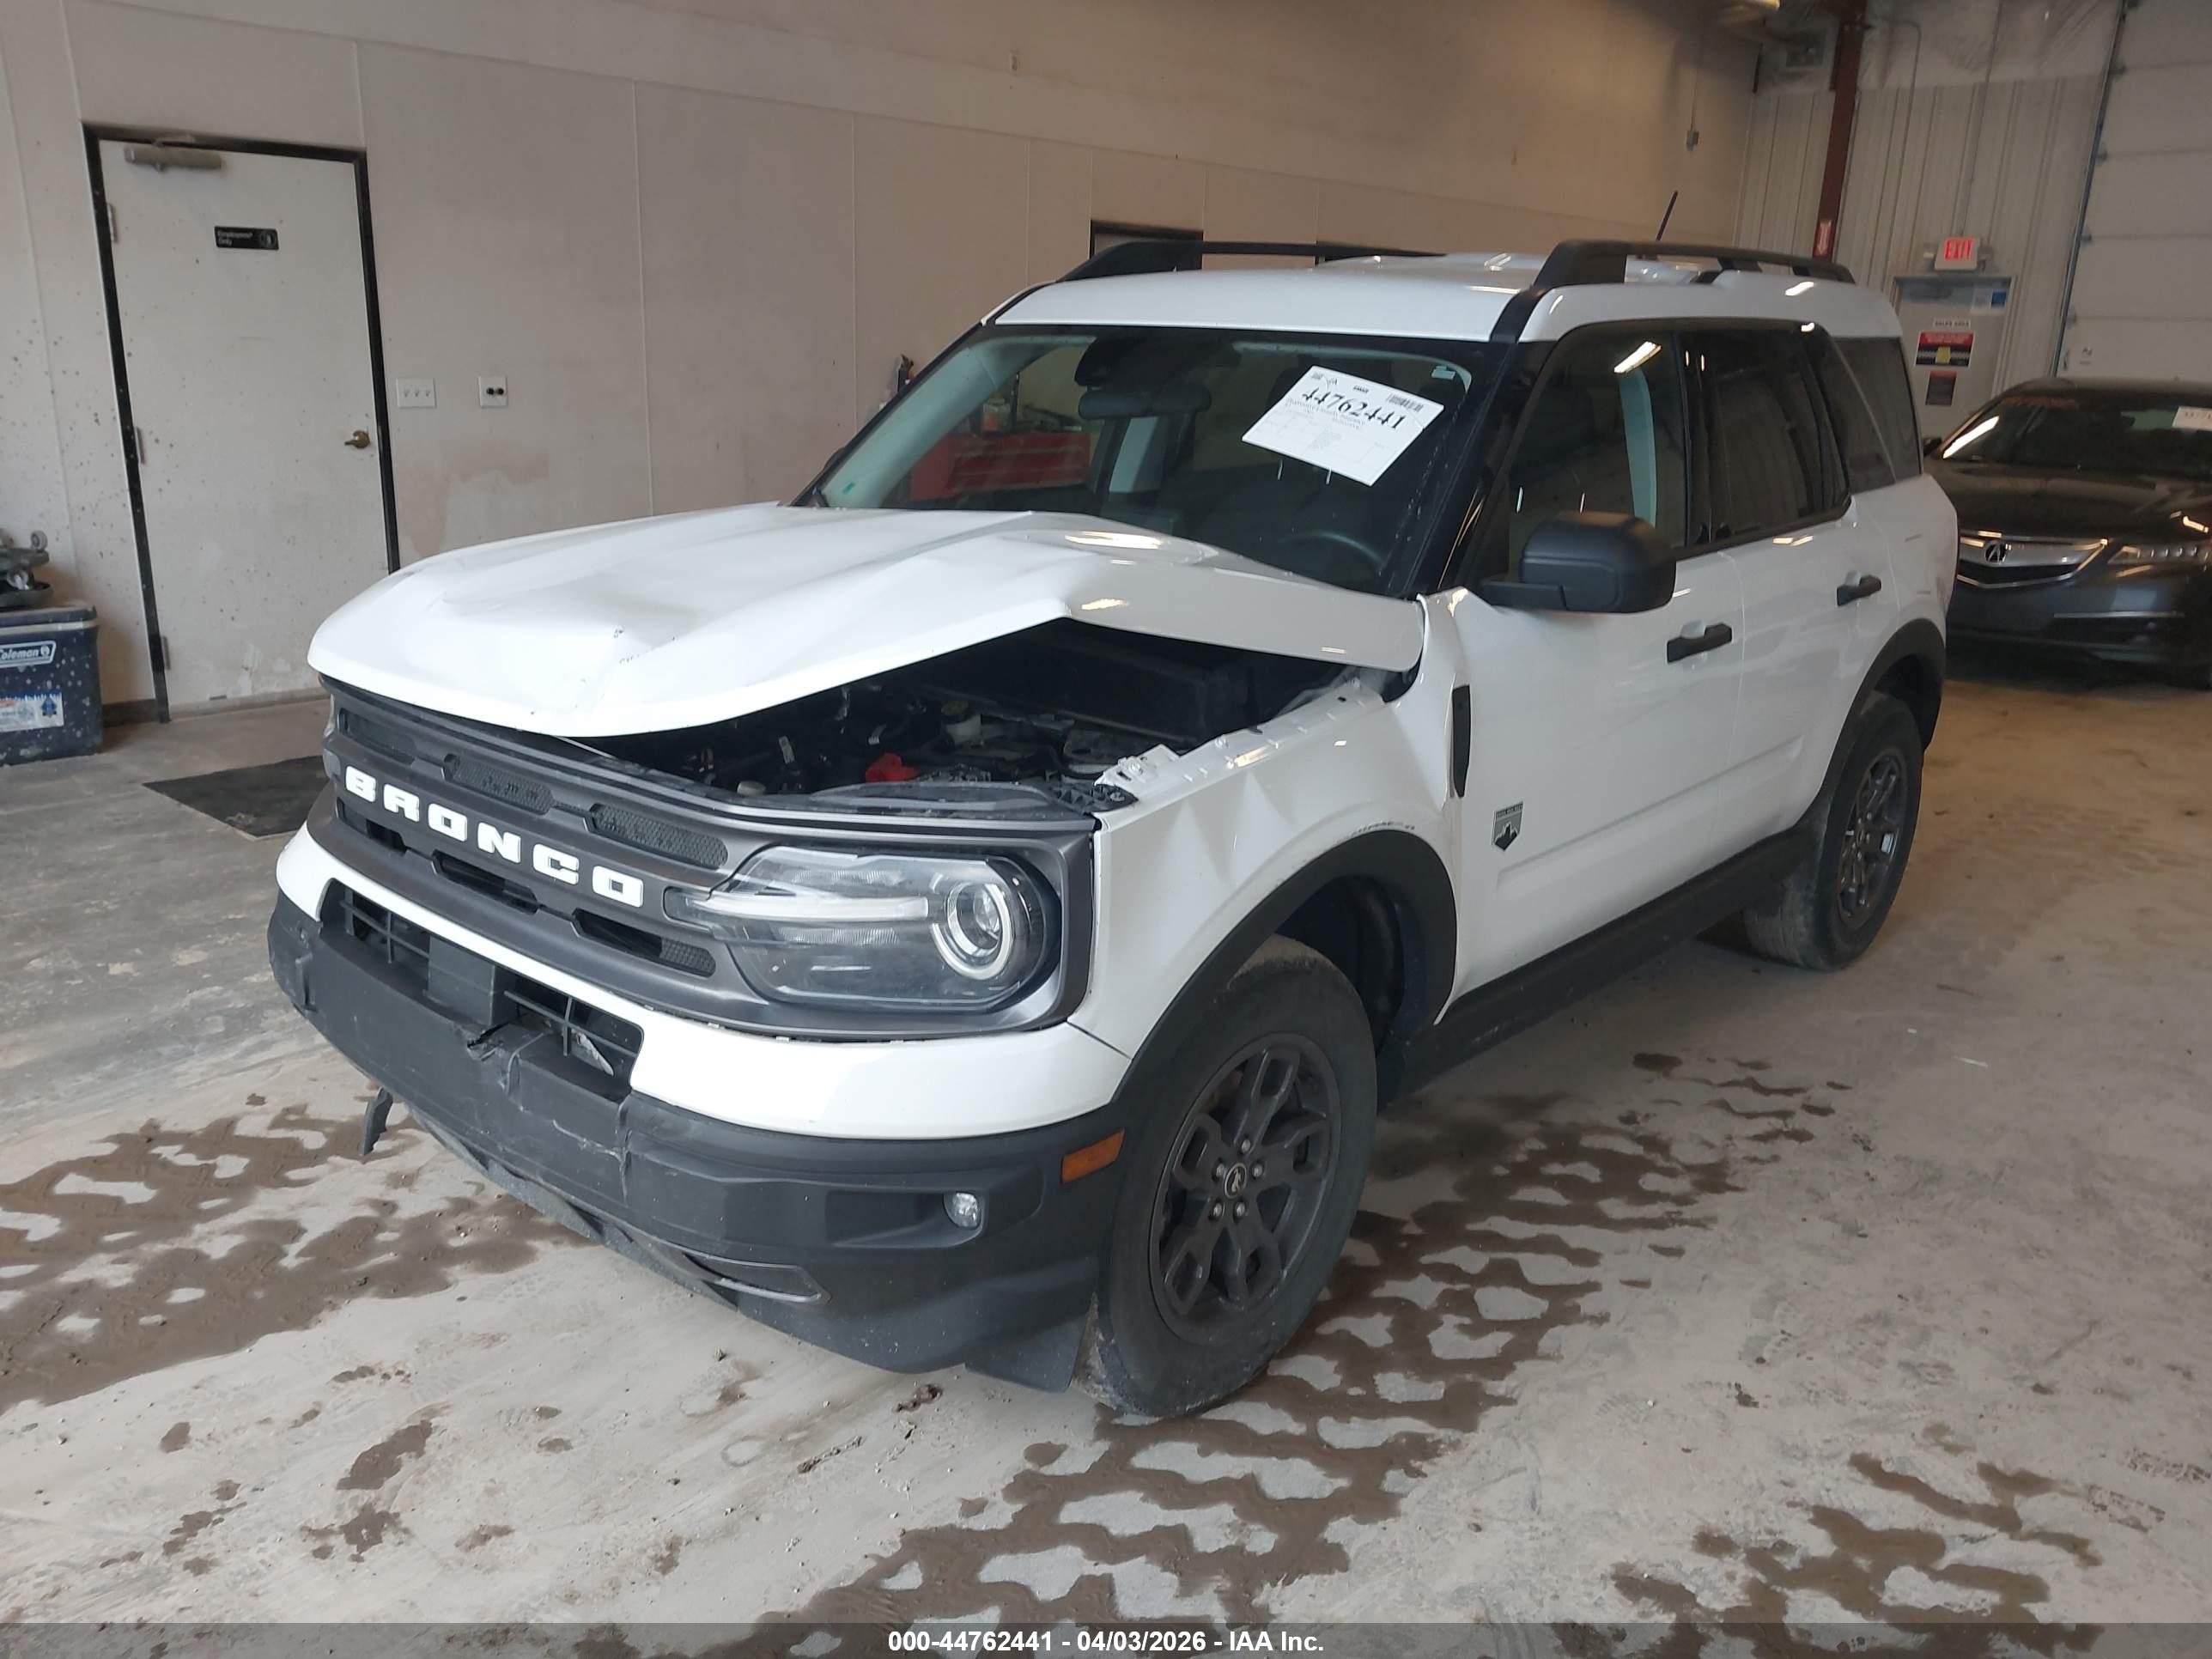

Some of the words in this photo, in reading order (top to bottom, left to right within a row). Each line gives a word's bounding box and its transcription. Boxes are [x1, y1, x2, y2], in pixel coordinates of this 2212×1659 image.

[1944, 238, 1974, 261] EXIT
[1301, 386, 1407, 430] 44762441
[344, 765, 644, 908] BRONCO
